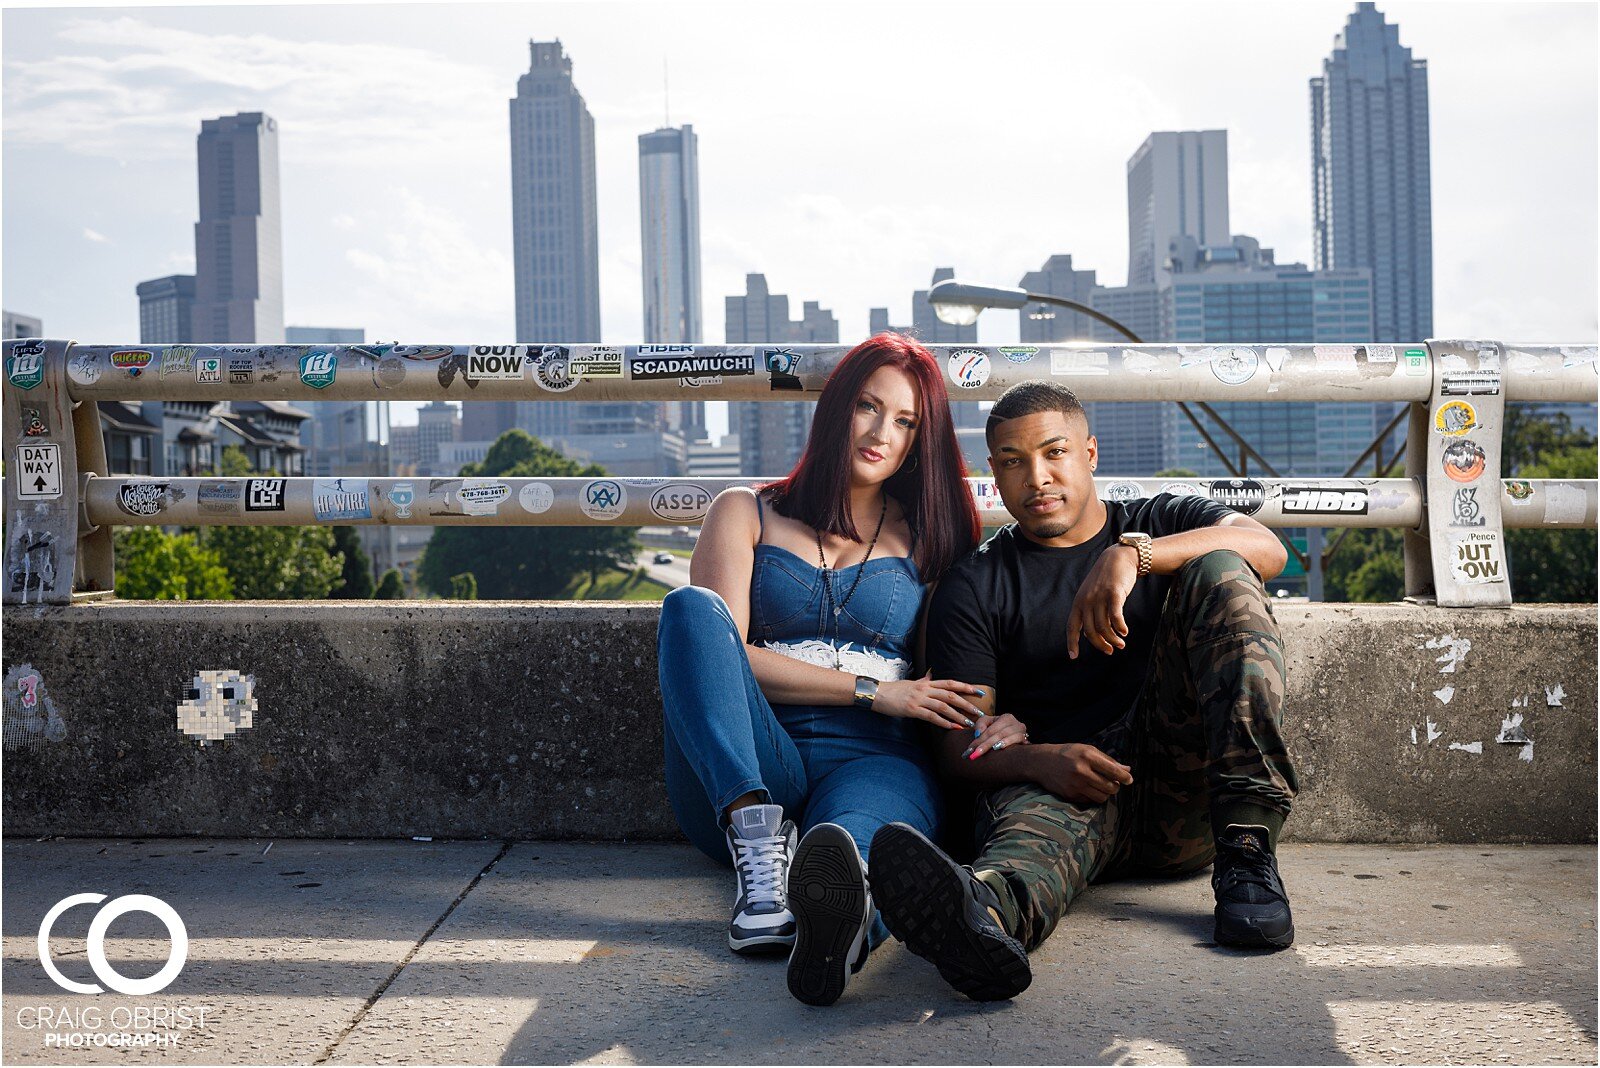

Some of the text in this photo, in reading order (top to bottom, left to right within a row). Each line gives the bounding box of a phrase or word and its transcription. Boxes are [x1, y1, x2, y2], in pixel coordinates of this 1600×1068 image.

[475, 345, 520, 356] OUT
[573, 353, 622, 362] UST GO!
[202, 361, 207, 371] I
[470, 356, 523, 373] NOW
[572, 364, 589, 373] NO!
[199, 371, 220, 382] ATL
[961, 379, 981, 388] LOGO
[24, 448, 52, 461] DAT
[23, 461, 54, 474] WAY
[136, 484, 156, 494] love
[462, 488, 506, 498] 678-768-3611
[977, 483, 988, 497] IF
[1213, 488, 1262, 499] HILLMAN
[316, 491, 366, 514] HI-WIRE
[655, 493, 708, 510] ASOP
[1225, 499, 1250, 507] BEER
[139, 502, 158, 515] latte
[1457, 560, 1499, 579] OW
